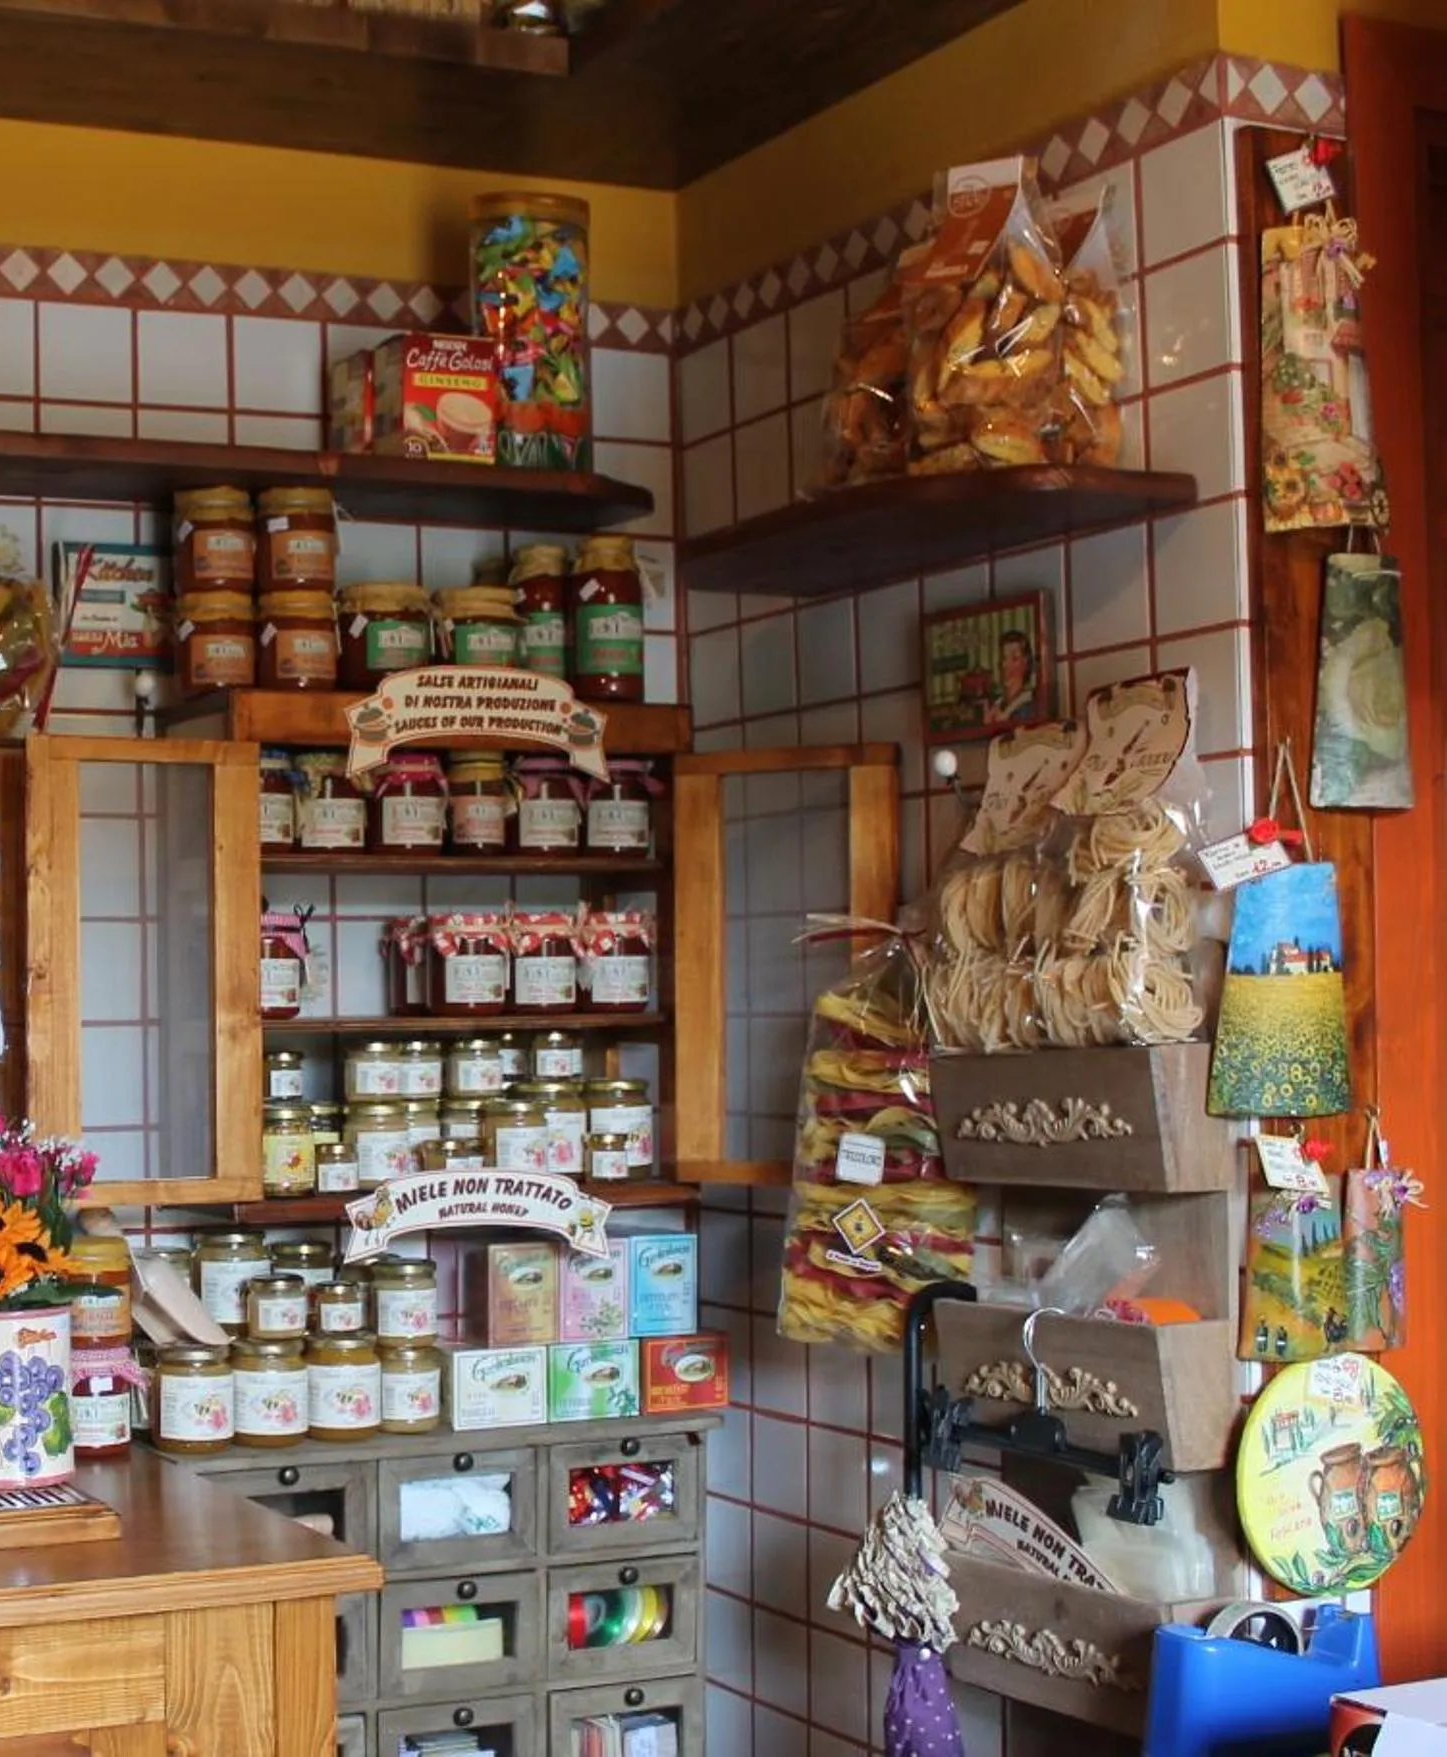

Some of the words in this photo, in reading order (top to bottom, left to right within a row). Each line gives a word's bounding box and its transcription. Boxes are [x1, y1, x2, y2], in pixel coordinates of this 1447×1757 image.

[416, 674, 454, 689] SALSE
[458, 675, 539, 691] ARTIGIANALI
[405, 695, 420, 708] DI
[423, 696, 472, 710] NOSTRA
[477, 697, 556, 712] PRODUZIONE
[395, 716, 438, 734] SAUCES
[440, 716, 455, 729] OF
[460, 716, 484, 730] OUR
[488, 717, 563, 736] PRODUCTION
[395, 1181, 448, 1214] MIELE
[453, 1178, 490, 1196] NON
[495, 1178, 573, 1211] TRATTATO
[438, 1202, 487, 1219] NATURAL
[491, 1203, 529, 1218] HONEY
[985, 1499, 1030, 1533] MIELE
[1032, 1525, 1066, 1560] NON
